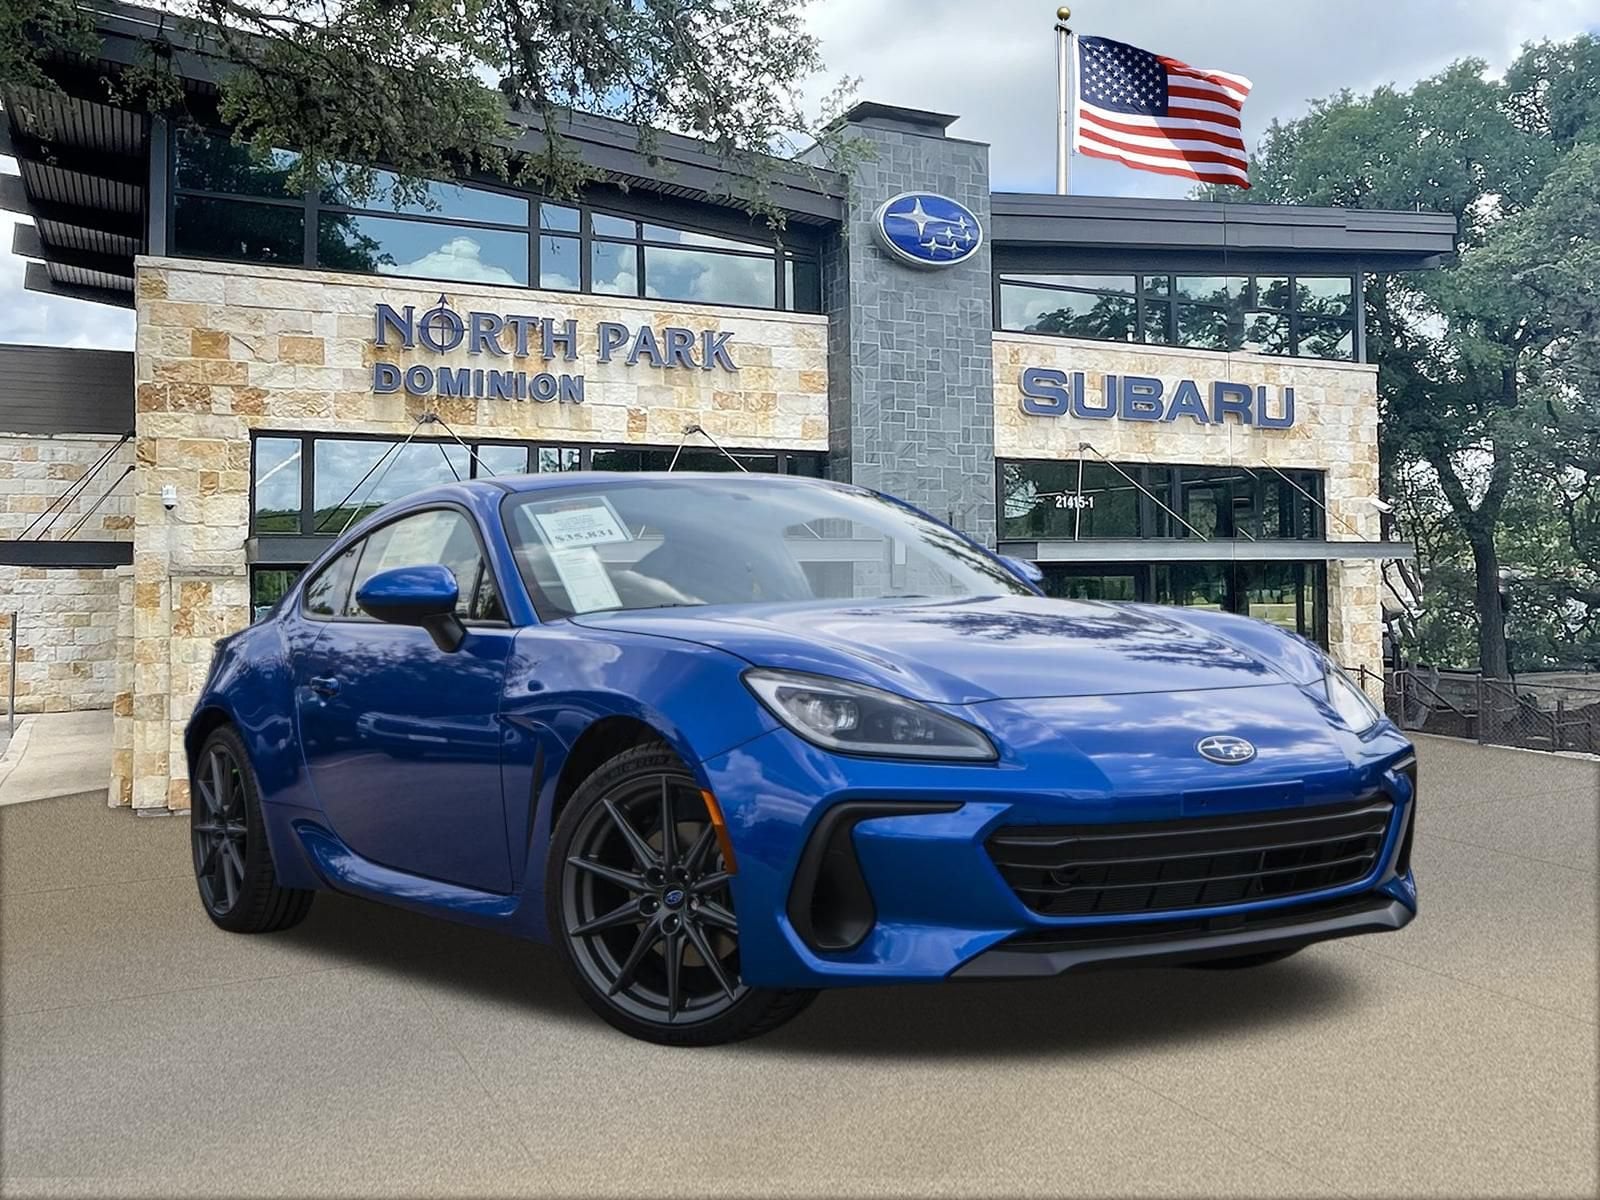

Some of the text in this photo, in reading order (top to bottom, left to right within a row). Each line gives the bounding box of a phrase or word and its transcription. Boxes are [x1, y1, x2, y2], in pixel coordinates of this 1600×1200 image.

[374, 294, 741, 373] NORTH PARK
[373, 362, 585, 404] DOMINION
[1019, 366, 1295, 430] SUBARU
